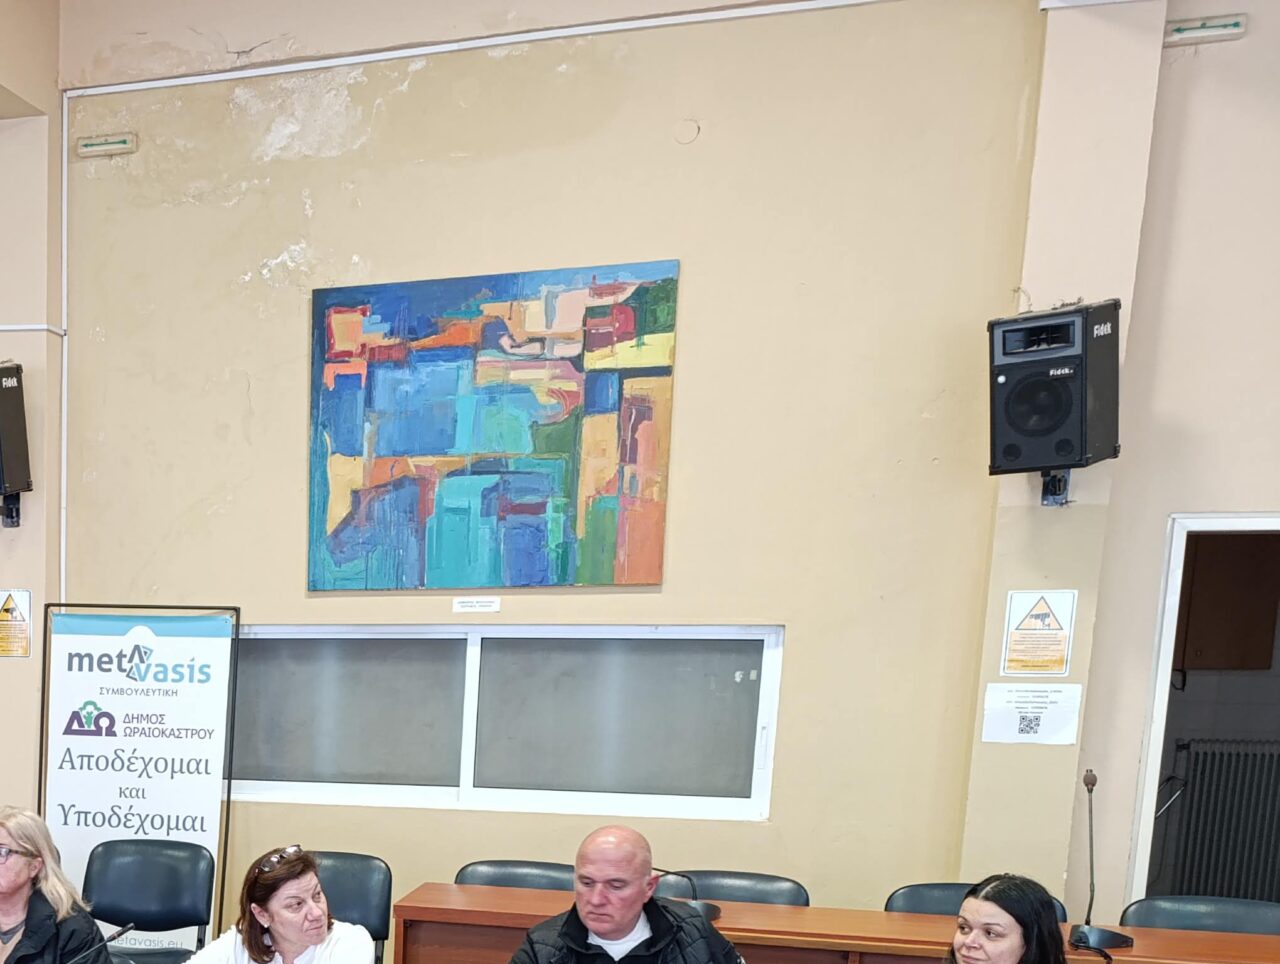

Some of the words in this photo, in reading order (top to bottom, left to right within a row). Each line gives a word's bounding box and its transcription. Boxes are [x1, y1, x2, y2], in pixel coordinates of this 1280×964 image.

[99, 687, 178, 697] ΣΥΜΒΟΥΛΕΥΤΙΚΗ
[123, 713, 166, 725] ΔΗΜΟΣ
[123, 727, 215, 740] ΩΡΑΙΟΚΑΣΤΡΟΥ
[57, 747, 211, 780] Αποδέχομαι
[119, 786, 147, 800] και
[57, 803, 208, 837] Υποδέχομαι
